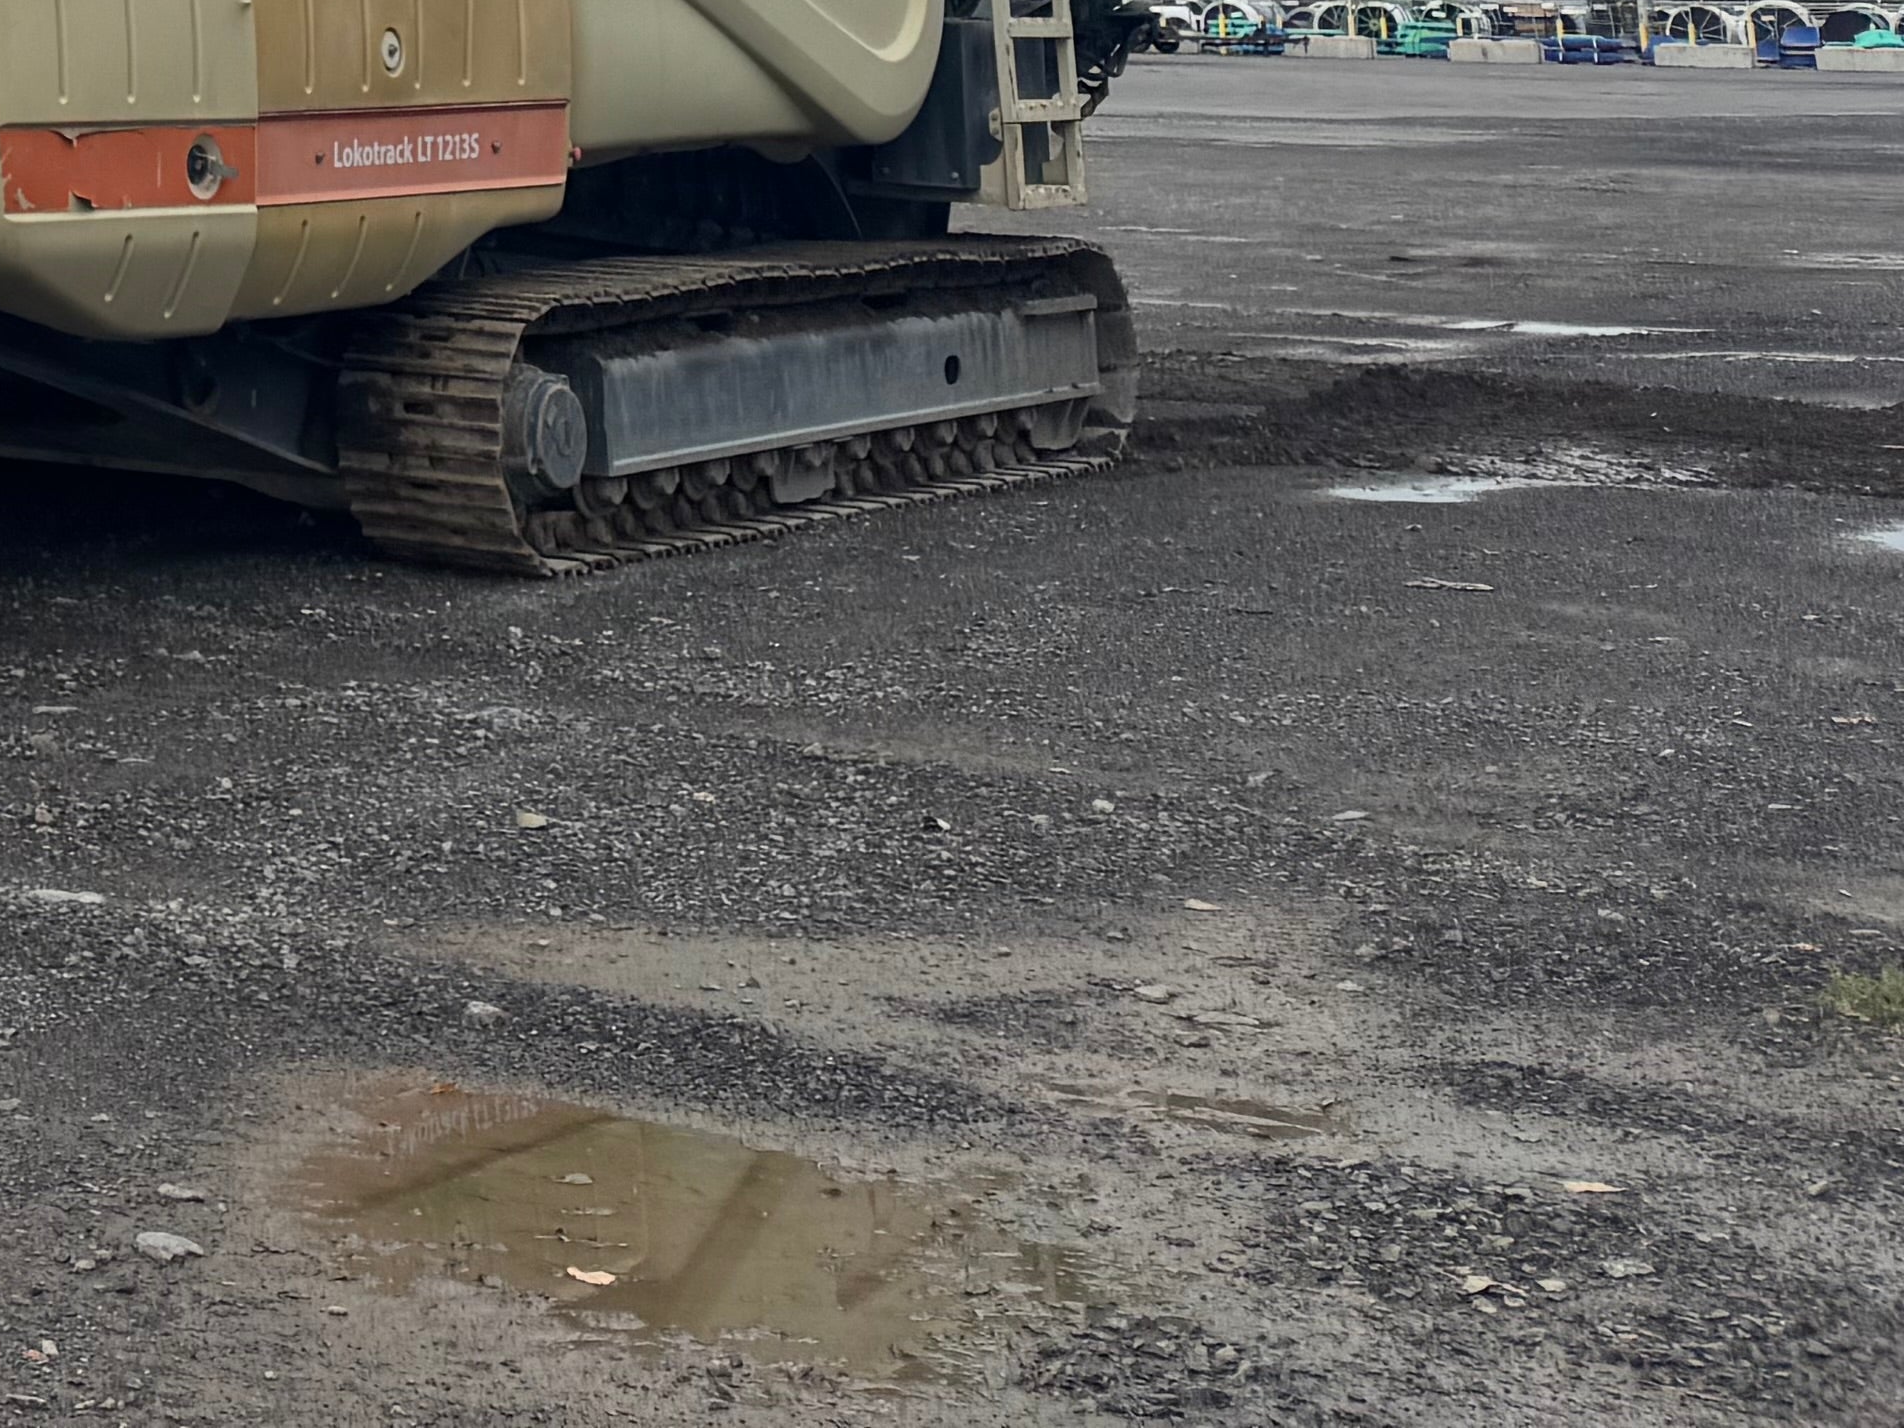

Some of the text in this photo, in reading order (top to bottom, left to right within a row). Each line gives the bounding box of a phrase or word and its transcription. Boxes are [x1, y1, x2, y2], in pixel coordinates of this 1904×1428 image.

[334, 133, 480, 168] Lokotrack LT 1213S
